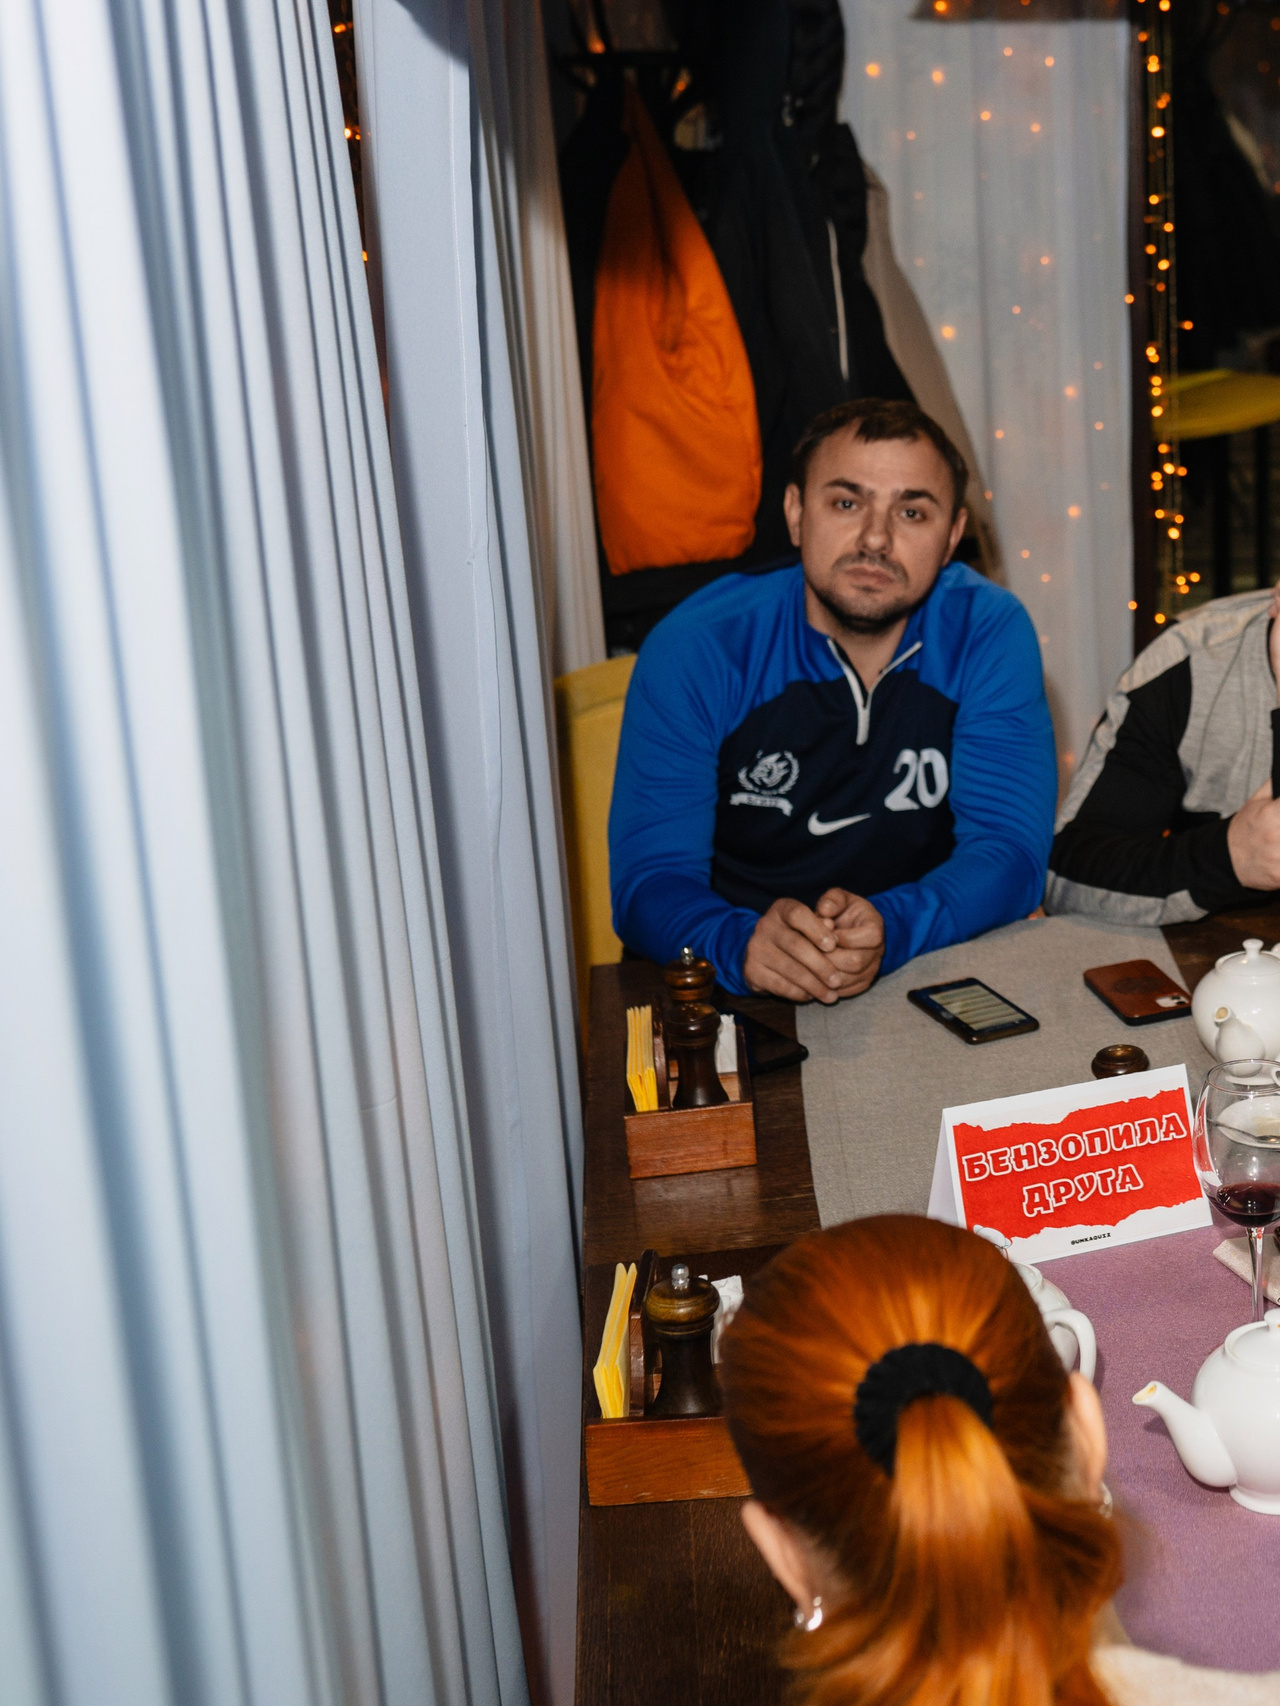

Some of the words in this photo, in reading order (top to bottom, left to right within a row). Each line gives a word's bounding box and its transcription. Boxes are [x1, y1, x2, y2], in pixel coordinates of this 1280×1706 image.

[884, 747, 949, 812] 20
[962, 1112, 1188, 1182] БЕНЗОПИЛА
[1022, 1163, 1144, 1218] ДРУГА
